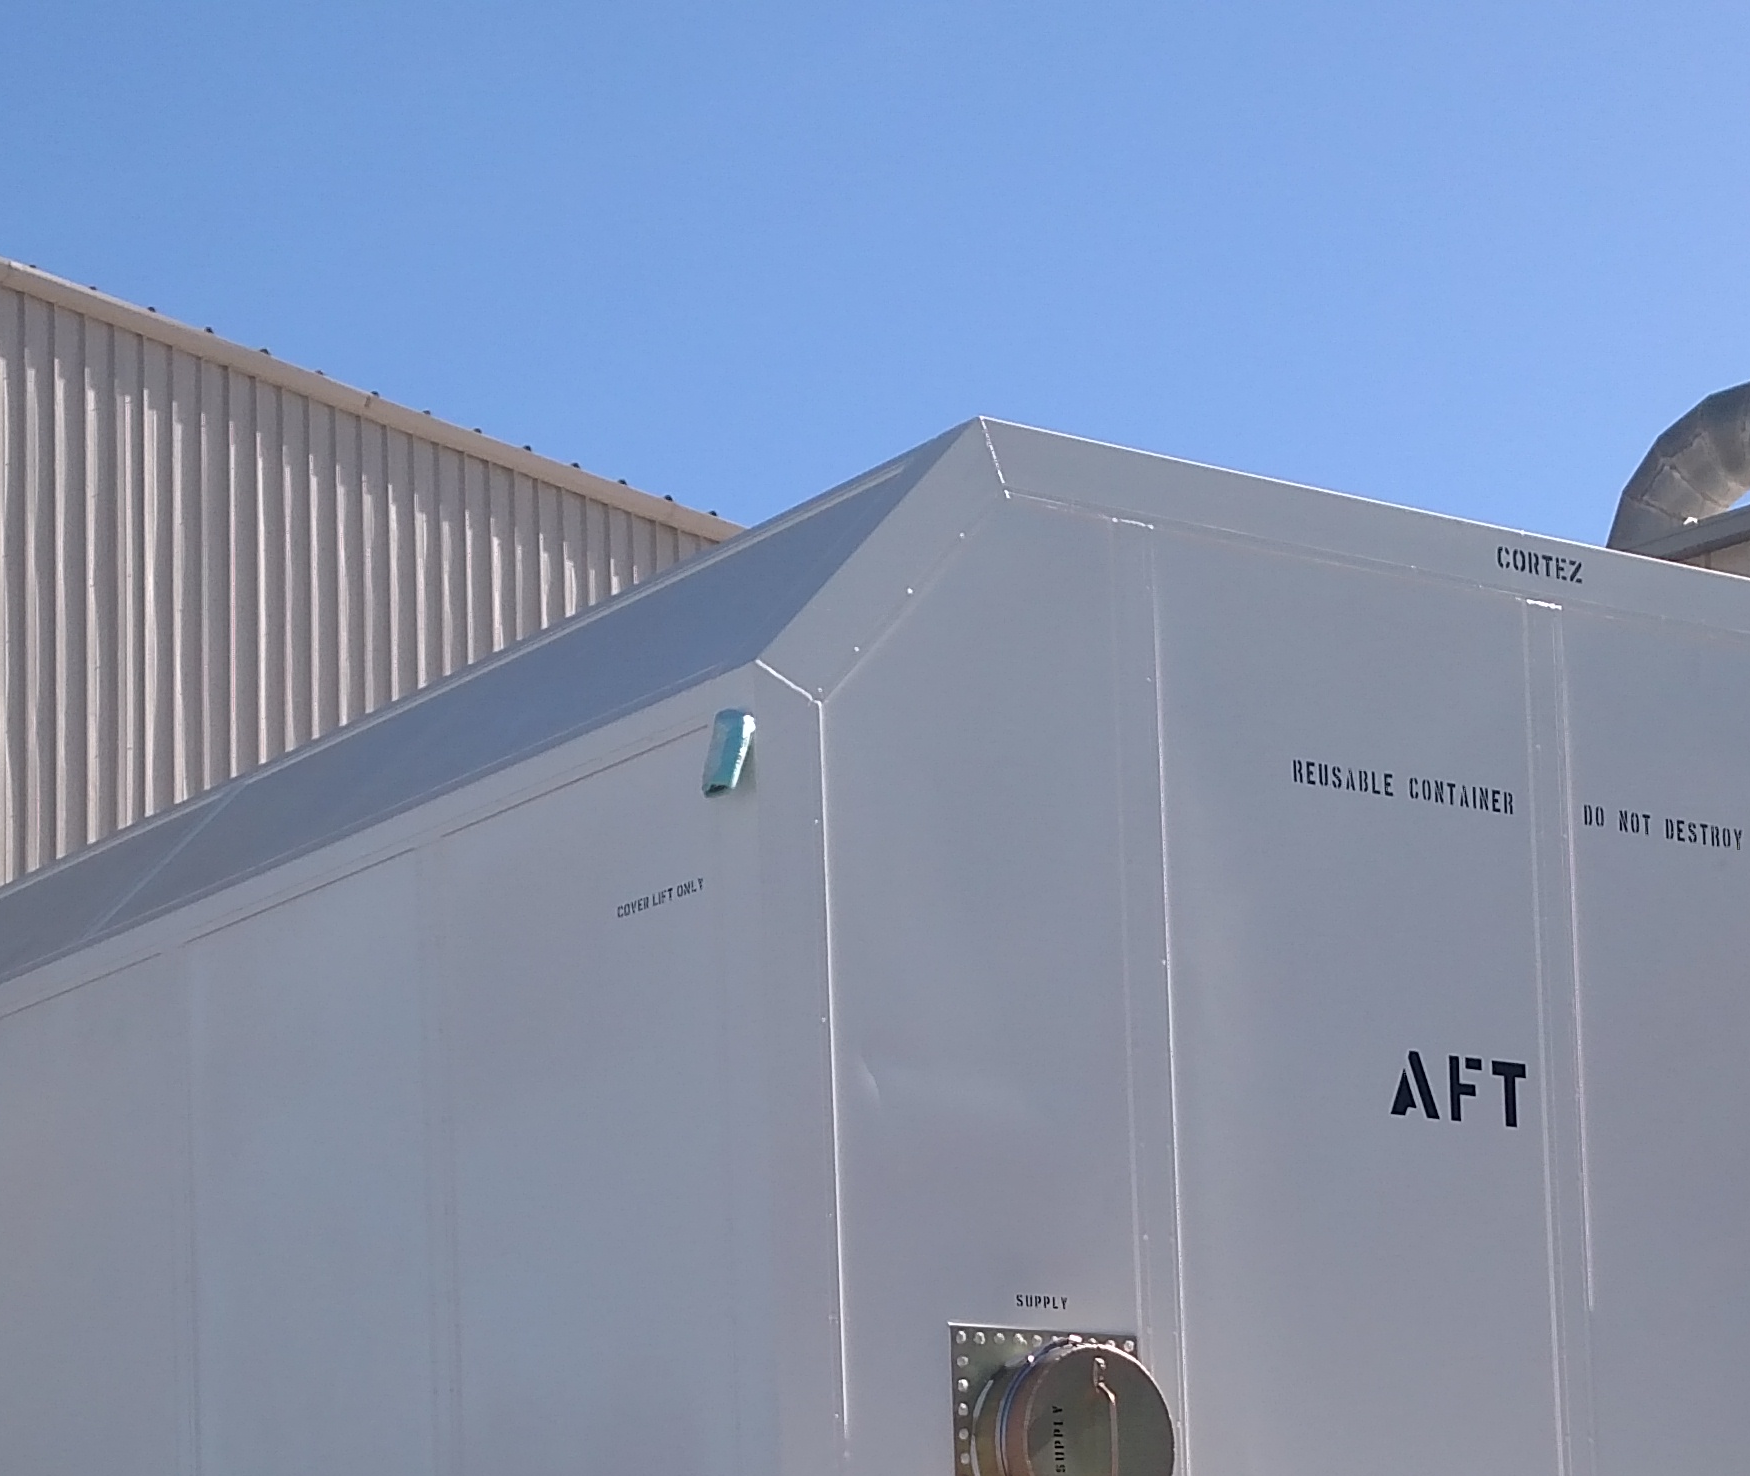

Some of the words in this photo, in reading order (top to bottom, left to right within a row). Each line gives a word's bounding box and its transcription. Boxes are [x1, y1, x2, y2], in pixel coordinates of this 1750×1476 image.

[1497, 546, 1583, 584] CORTEZ
[1292, 759, 1394, 797] REUSABLE
[1409, 777, 1514, 815] CONTAINER
[1583, 804, 1605, 827] DO
[1619, 810, 1651, 835] NOT
[1665, 818, 1743, 851] DESTROY
[617, 896, 650, 919] COVER
[652, 887, 674, 908] LIFT
[676, 877, 704, 899] ONLY
[1390, 1050, 1527, 1128] AFT
[1015, 1293, 1068, 1310] SUPPLY
[1052, 1405, 1066, 1473] SUPPLY
